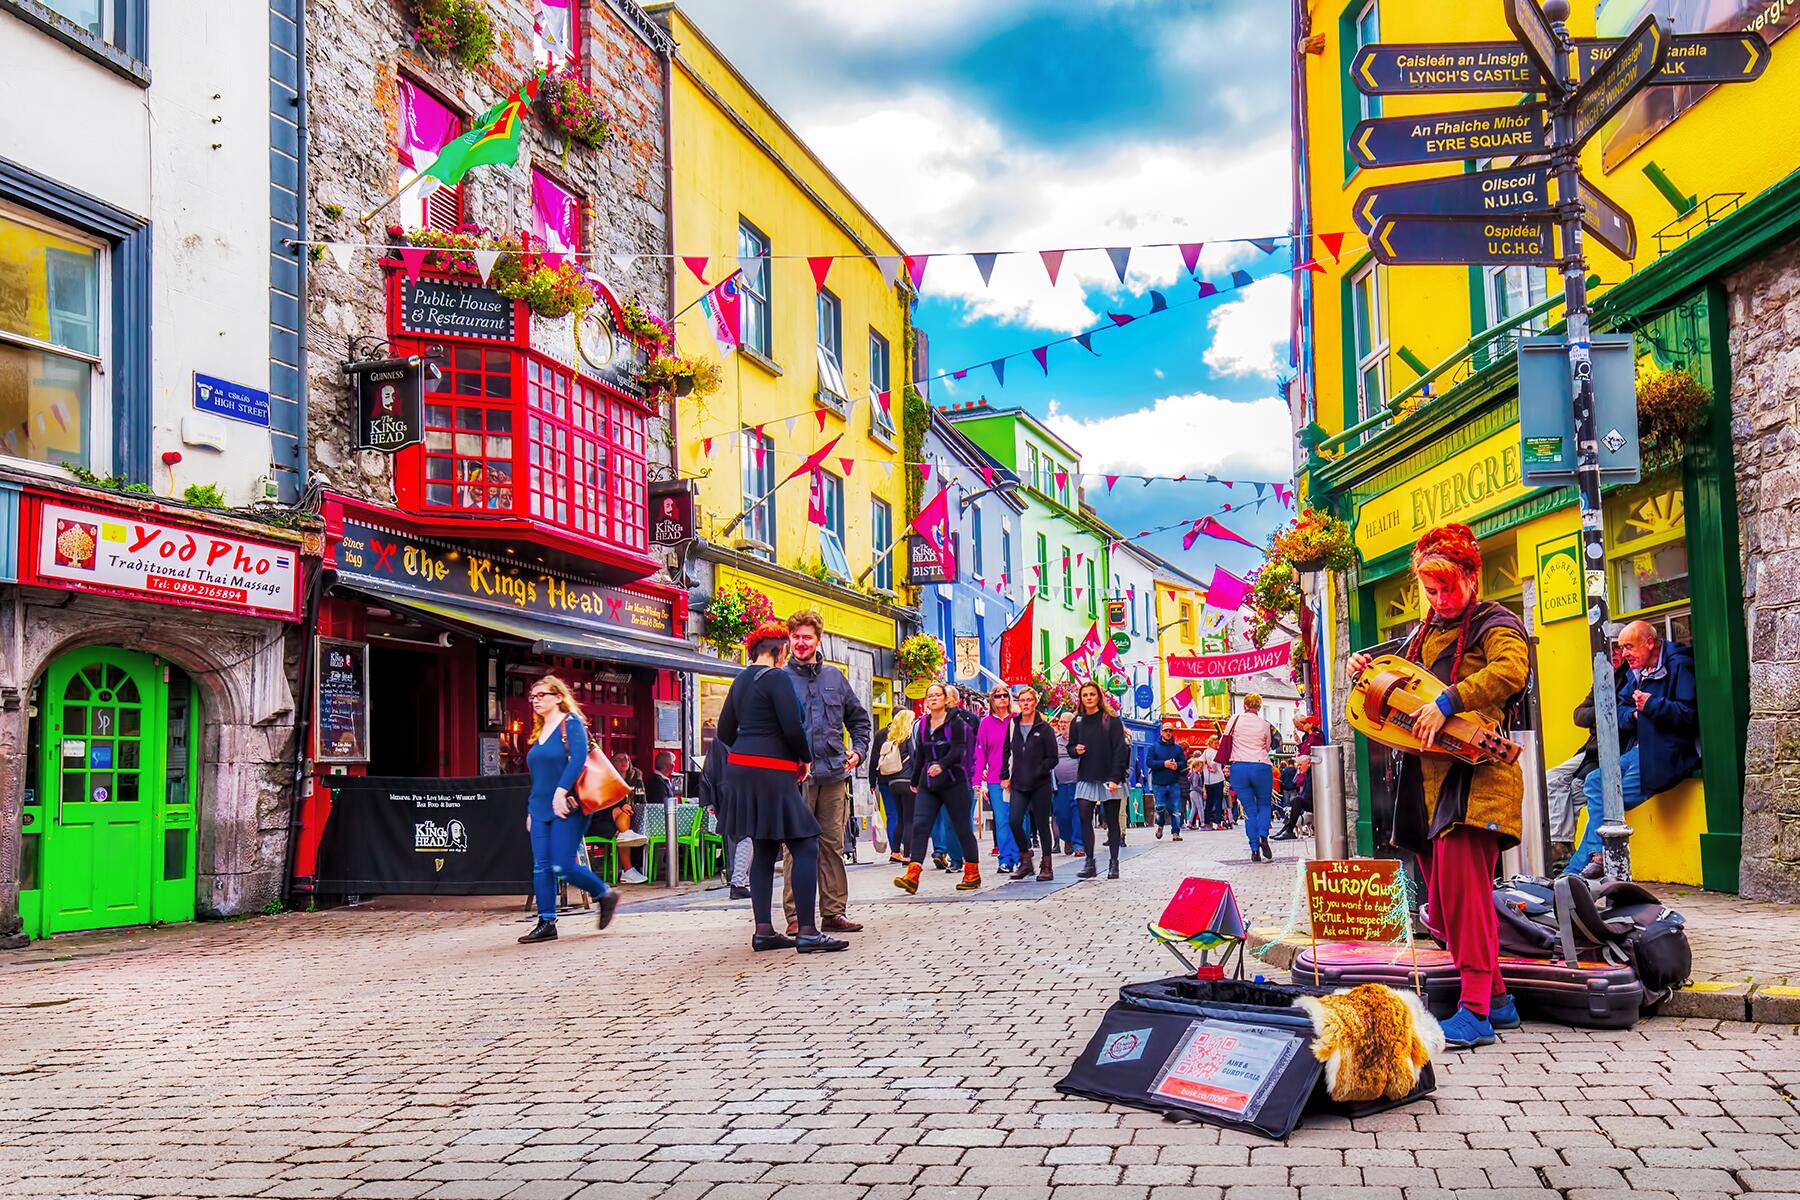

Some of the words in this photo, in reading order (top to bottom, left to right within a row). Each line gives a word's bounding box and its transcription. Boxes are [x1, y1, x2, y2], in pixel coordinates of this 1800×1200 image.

[1667, 44, 1707, 57] anála
[1396, 54, 1454, 67] Caisleán
[1458, 56, 1474, 66] an
[1478, 53, 1528, 66] Linsigh
[1409, 70, 1469, 84] LYNCH'S
[1473, 69, 1530, 82] CASTLE
[1605, 65, 1638, 105] WINDOW
[1411, 125, 1431, 137] An
[1435, 121, 1490, 135] Fhaiche
[1494, 116, 1530, 129] Mhór
[1426, 139, 1466, 152] EYRE
[1470, 132, 1532, 148] SQUARE
[1482, 173, 1536, 192] Ollscoil
[1484, 190, 1539, 209] N.U.I.G.
[1484, 224, 1540, 240] Ospidéal
[1488, 242, 1543, 254] U.C.H.G.
[414, 289, 456, 308] Public
[460, 294, 502, 312] House
[411, 308, 424, 322] &
[427, 308, 505, 329] Restaurant
[370, 371, 404, 382] GUINNESS
[214, 396, 235, 410] HIGH
[238, 403, 267, 418] STREET
[370, 432, 405, 444] HEAD
[1365, 509, 1401, 539] HEALTH
[342, 536, 364, 550] Since
[656, 531, 682, 541] HEAD
[127, 525, 197, 562] Yod
[206, 540, 271, 575] Pho
[345, 551, 363, 568] 1649
[108, 554, 191, 578] Traditional
[196, 569, 227, 585] Thai
[230, 575, 281, 596] Massage
[913, 565, 944, 577] BISTR
[1544, 561, 1577, 594] EVERGREEN
[152, 578, 170, 590] Tel:
[173, 581, 242, 600] 089-2165894
[403, 545, 449, 582] The
[467, 555, 537, 607] Kings
[548, 576, 603, 616] Head
[1545, 592, 1578, 610] CORNER
[1207, 660, 1226, 675] ON
[1227, 650, 1282, 673] GALWAY
[425, 820, 435, 828] The
[415, 837, 446, 847] HEAD
[1312, 896, 1324, 912] If
[1325, 900, 1340, 914] you
[1341, 901, 1362, 910] want
[1364, 902, 1373, 911] to
[1313, 912, 1345, 924] PICTUE,
[1346, 912, 1355, 924] be
[1323, 925, 1337, 936] Ask
[1337, 927, 1350, 935] and
[1351, 927, 1364, 935] TIP
[1363, 927, 1381, 940] first
